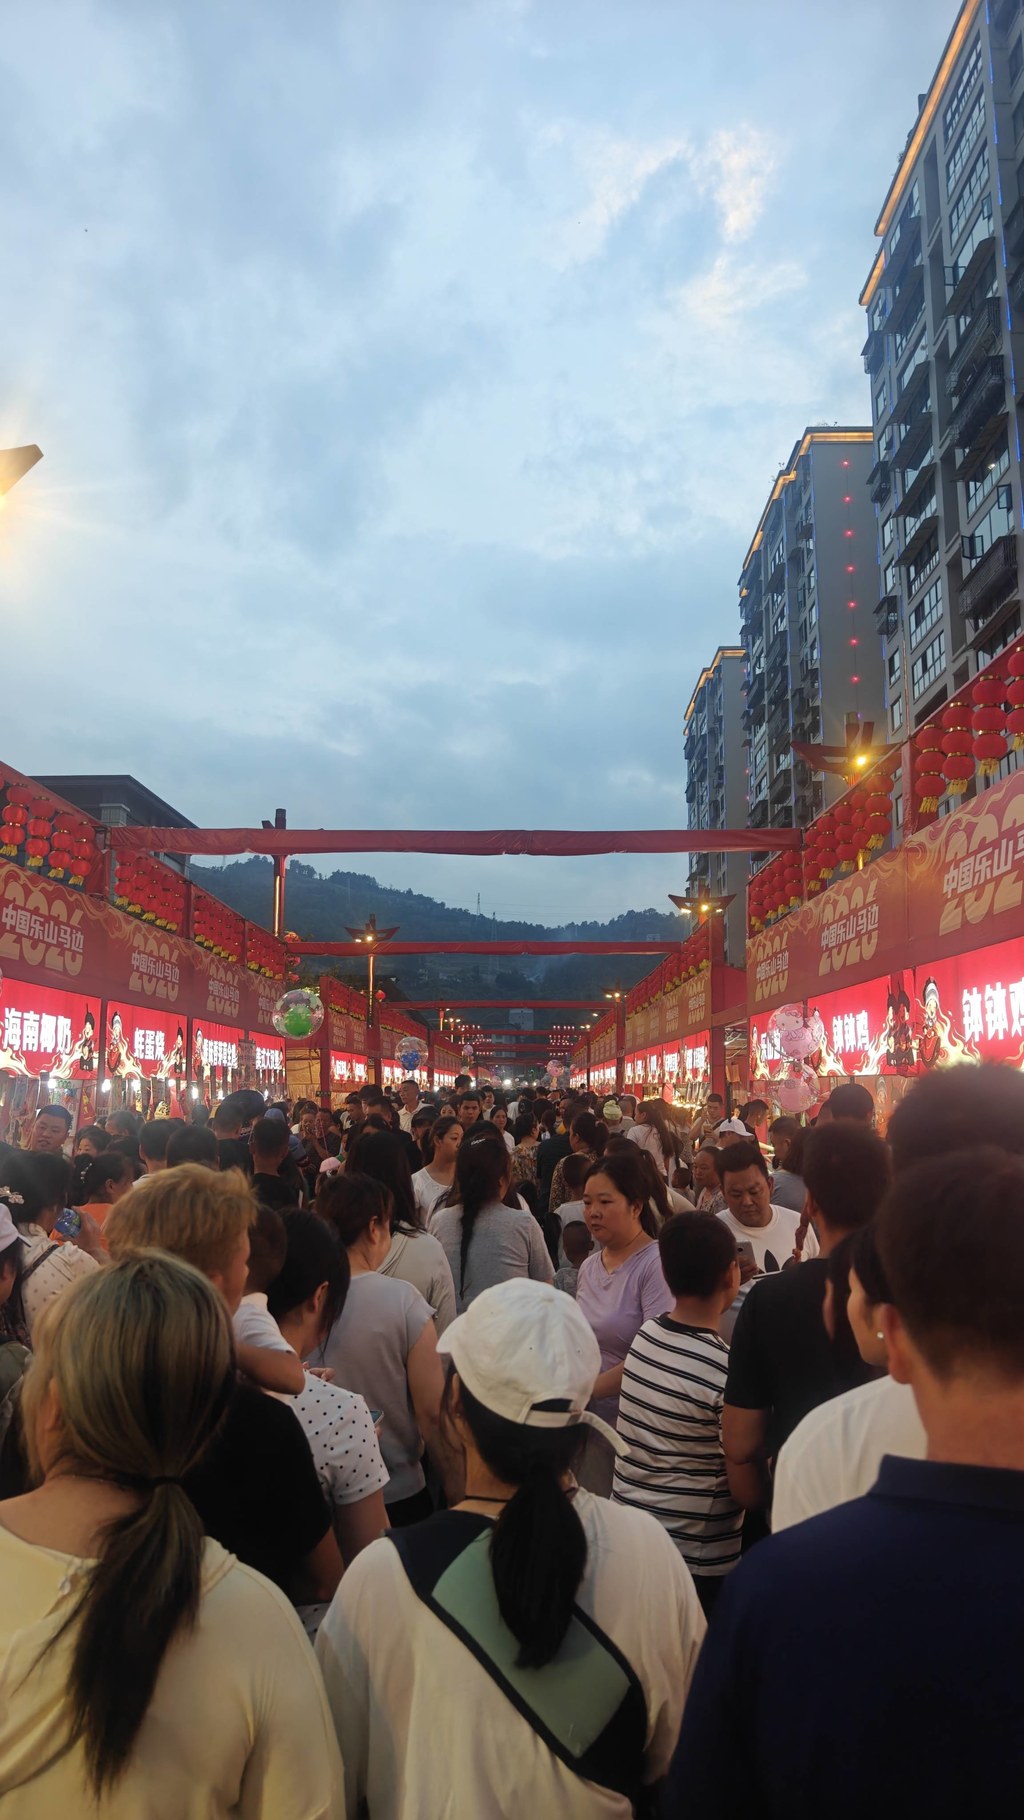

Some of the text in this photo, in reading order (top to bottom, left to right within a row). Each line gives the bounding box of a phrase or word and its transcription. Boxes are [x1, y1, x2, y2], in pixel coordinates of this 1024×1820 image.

[2, 903, 84, 953] 中国乐山马边
[820, 903, 879, 950] 中国乐山马边
[131, 950, 180, 983] 中国乐山马边
[756, 950, 789, 981] 中国乐山马边
[3, 1008, 72, 1054] 海南椰奶
[832, 1009, 869, 1053] 钵钵鸡
